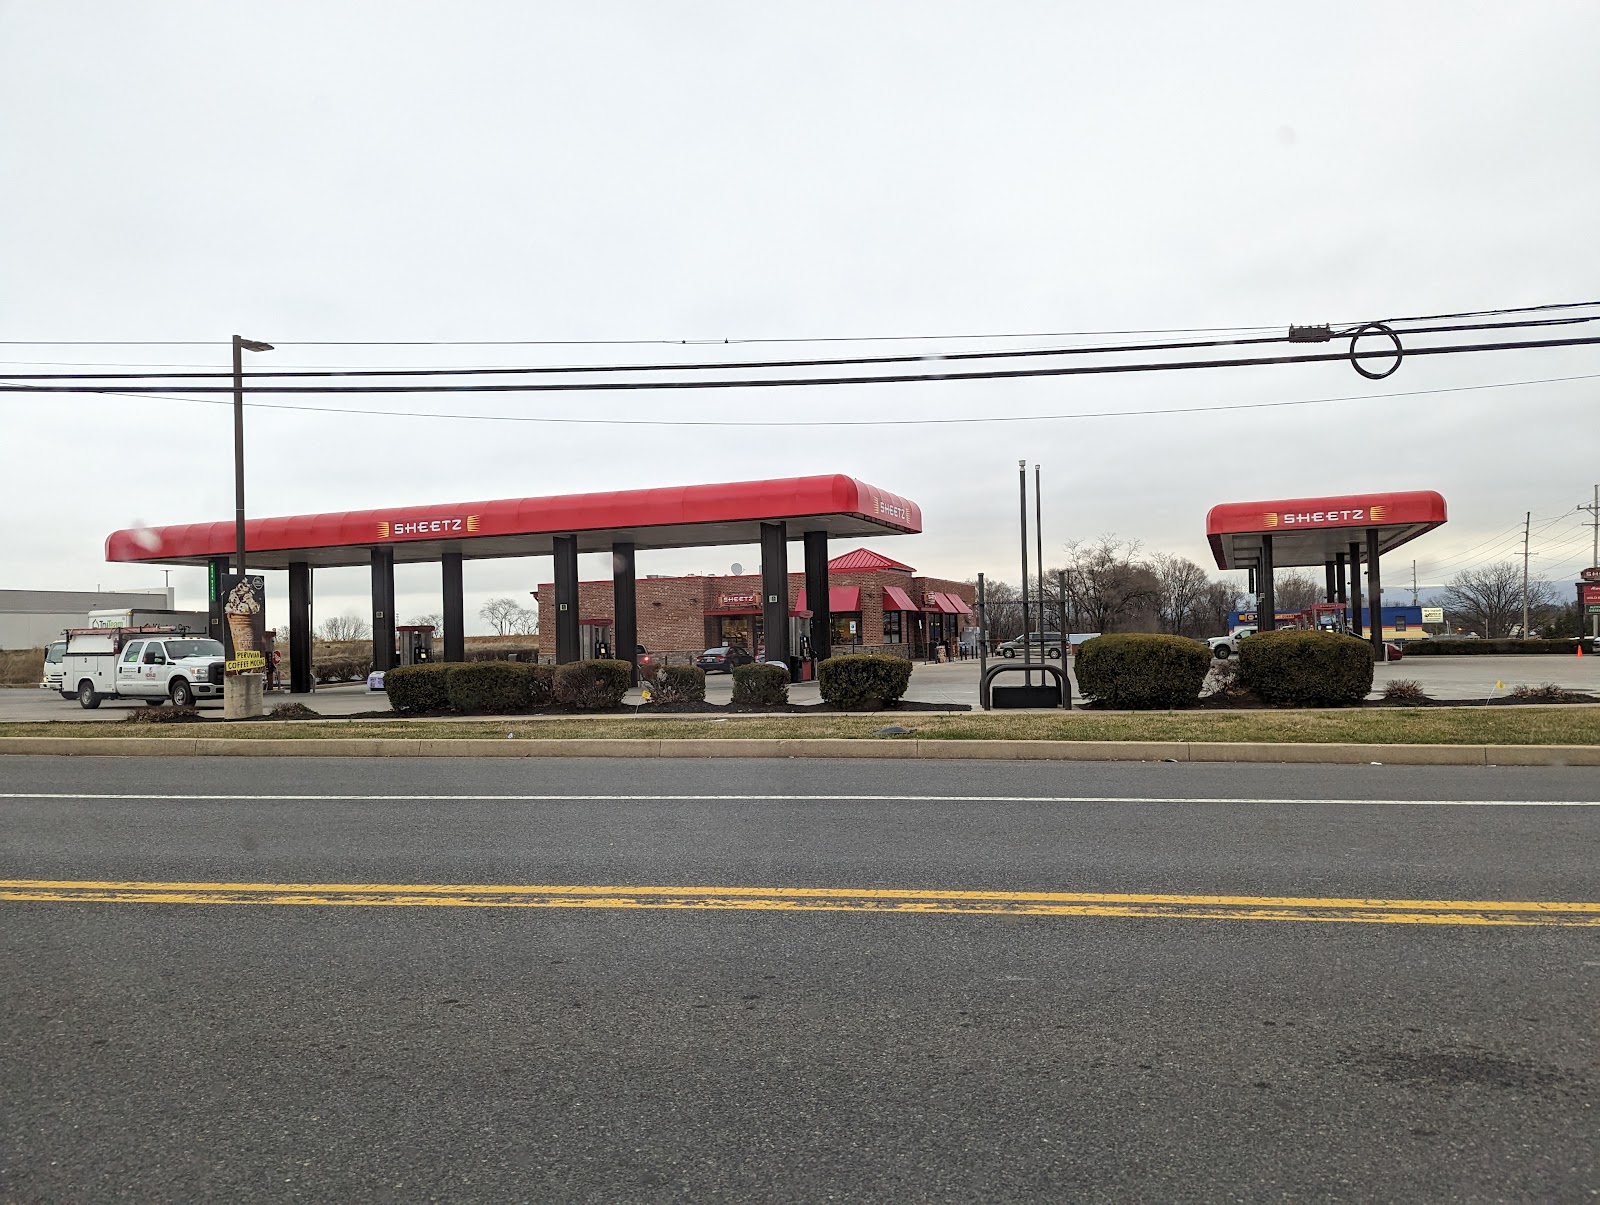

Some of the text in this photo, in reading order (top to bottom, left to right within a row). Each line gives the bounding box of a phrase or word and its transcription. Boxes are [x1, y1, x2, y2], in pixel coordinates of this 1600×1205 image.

[880, 502, 906, 520] SHEETZ
[1284, 510, 1364, 524] SHEETZ
[394, 519, 462, 534] SHEETZ
[237, 651, 260, 659] PERUVIAN
[228, 661, 249, 670] COFFEE
